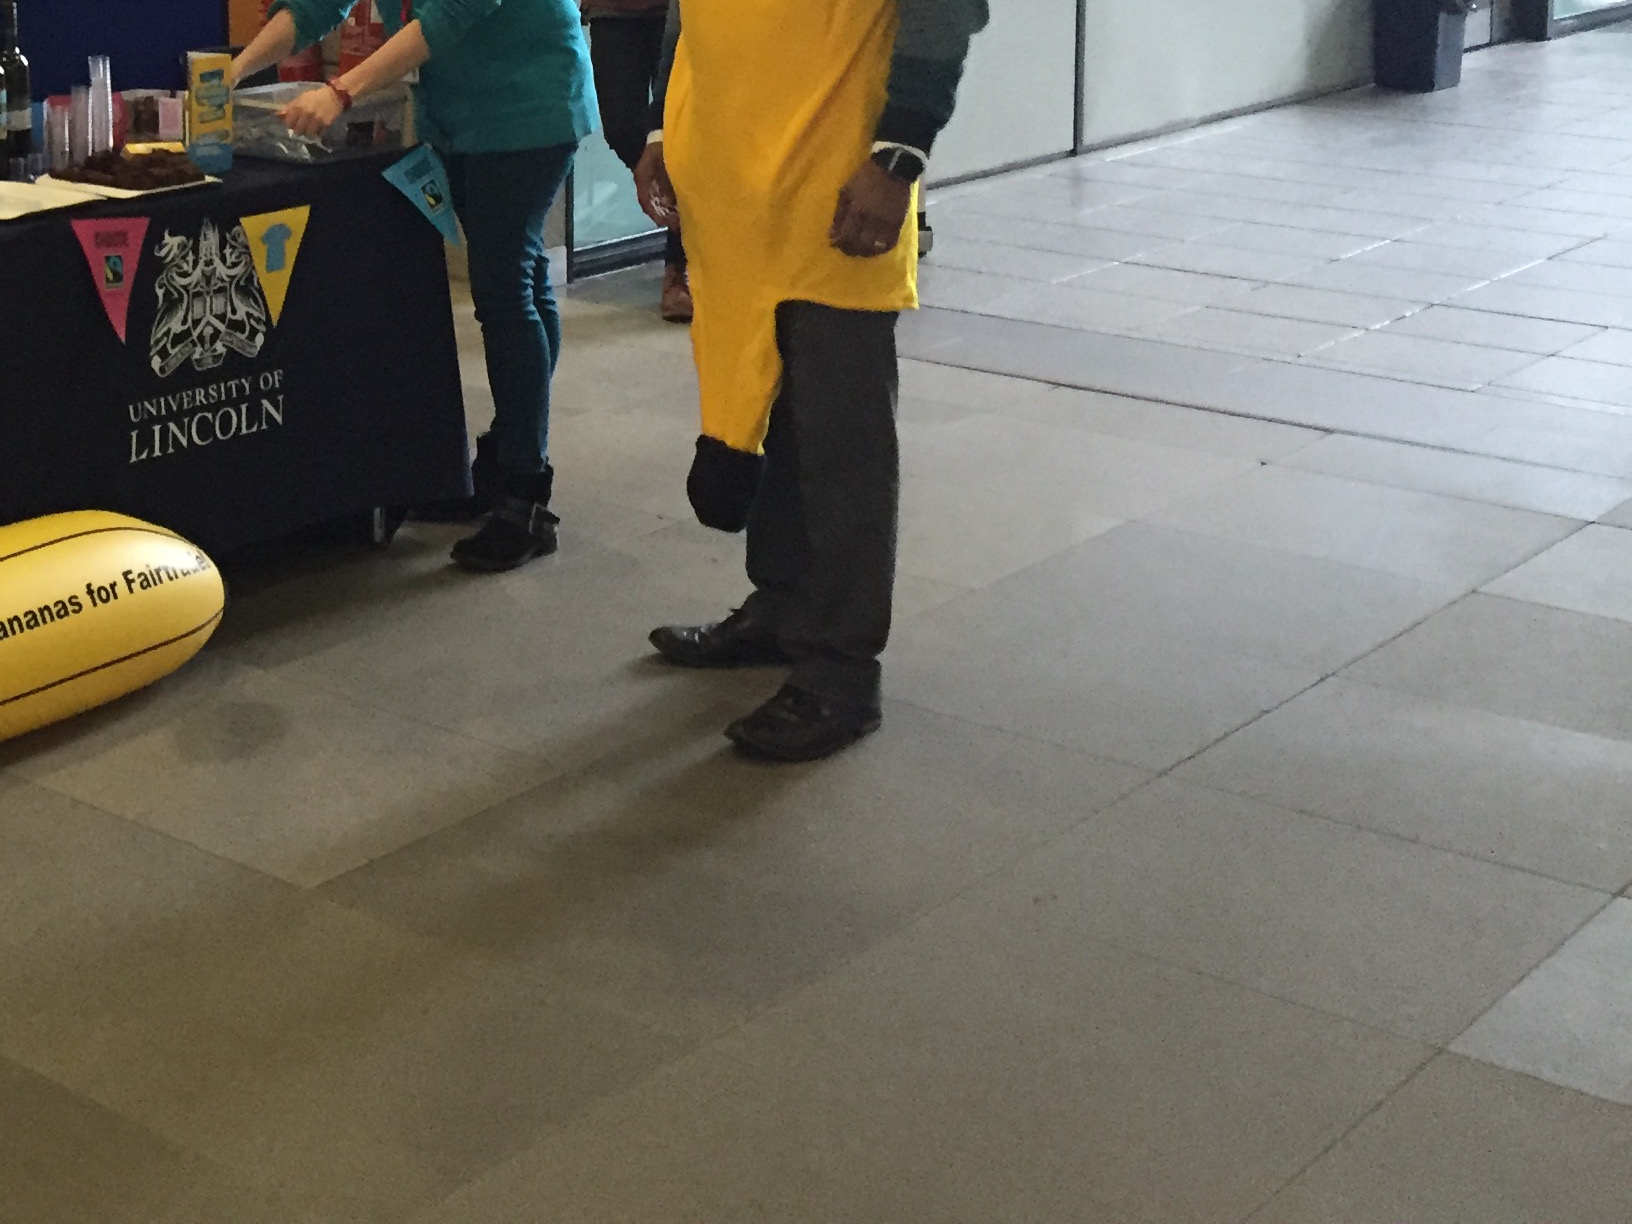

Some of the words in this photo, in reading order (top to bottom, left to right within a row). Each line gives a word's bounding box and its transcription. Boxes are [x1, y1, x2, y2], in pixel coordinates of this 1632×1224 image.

[128, 376, 252, 423] UNIVERSITY
[259, 369, 283, 391] OF
[129, 394, 284, 464] LINCOLN
[86, 582, 119, 608] for
